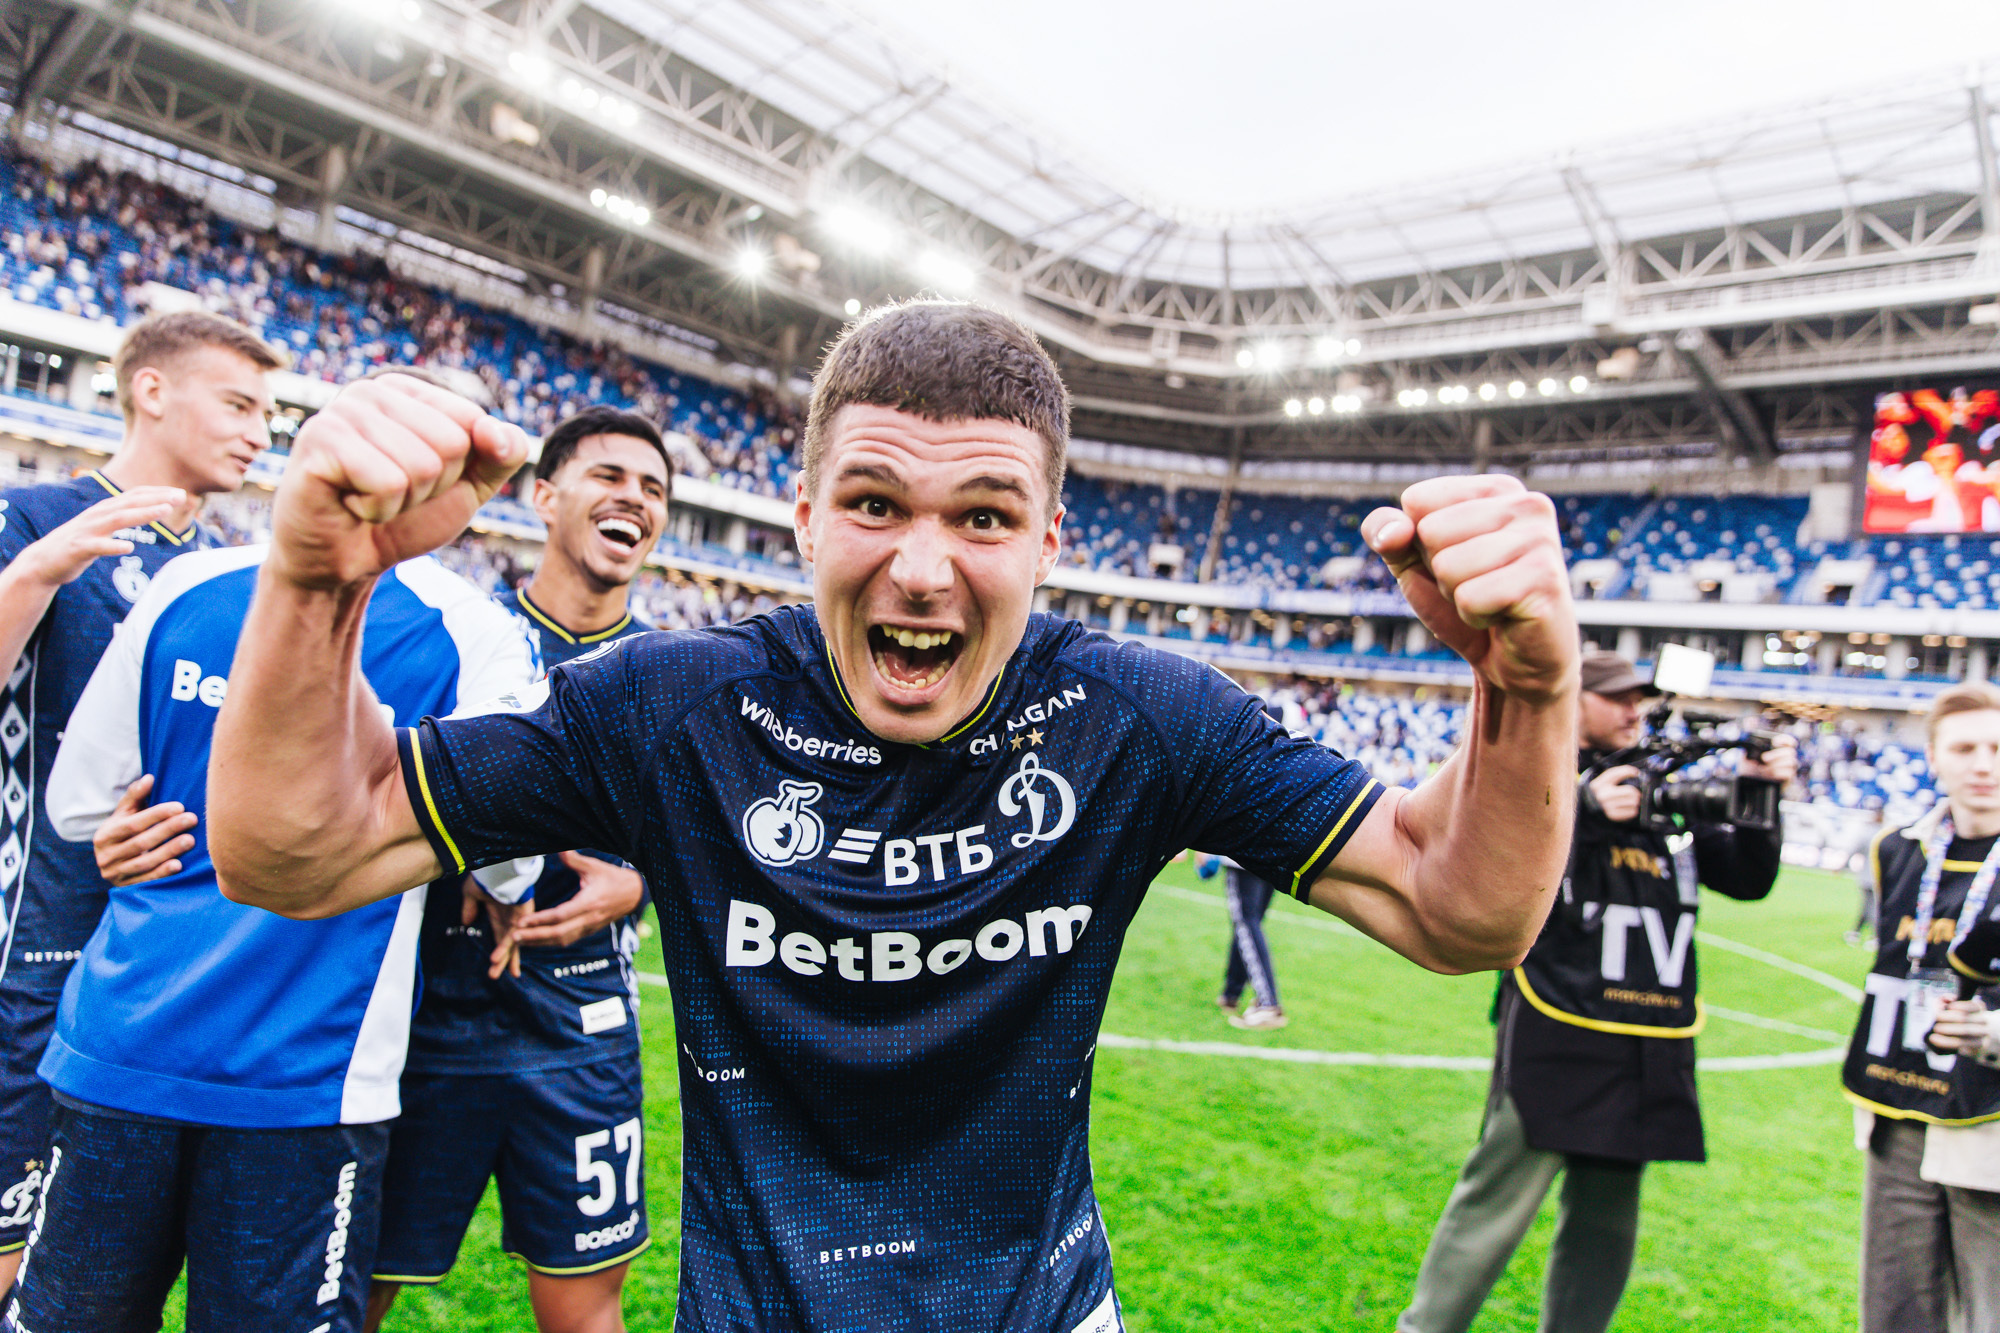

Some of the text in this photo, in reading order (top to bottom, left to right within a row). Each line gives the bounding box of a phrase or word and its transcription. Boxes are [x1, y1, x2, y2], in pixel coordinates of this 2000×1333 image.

[740, 696, 882, 765] Wildberries
[970, 684, 1086, 755] CHNGAN
[24, 950, 82, 962] BETBOO
[725, 899, 1092, 982] BetBoom
[1583, 901, 1695, 987] TV
[575, 1117, 641, 1216] 57
[316, 1161, 357, 1306] BetBoom
[575, 1220, 635, 1251] BOSCO
[820, 1240, 915, 1264] BETBOOM
